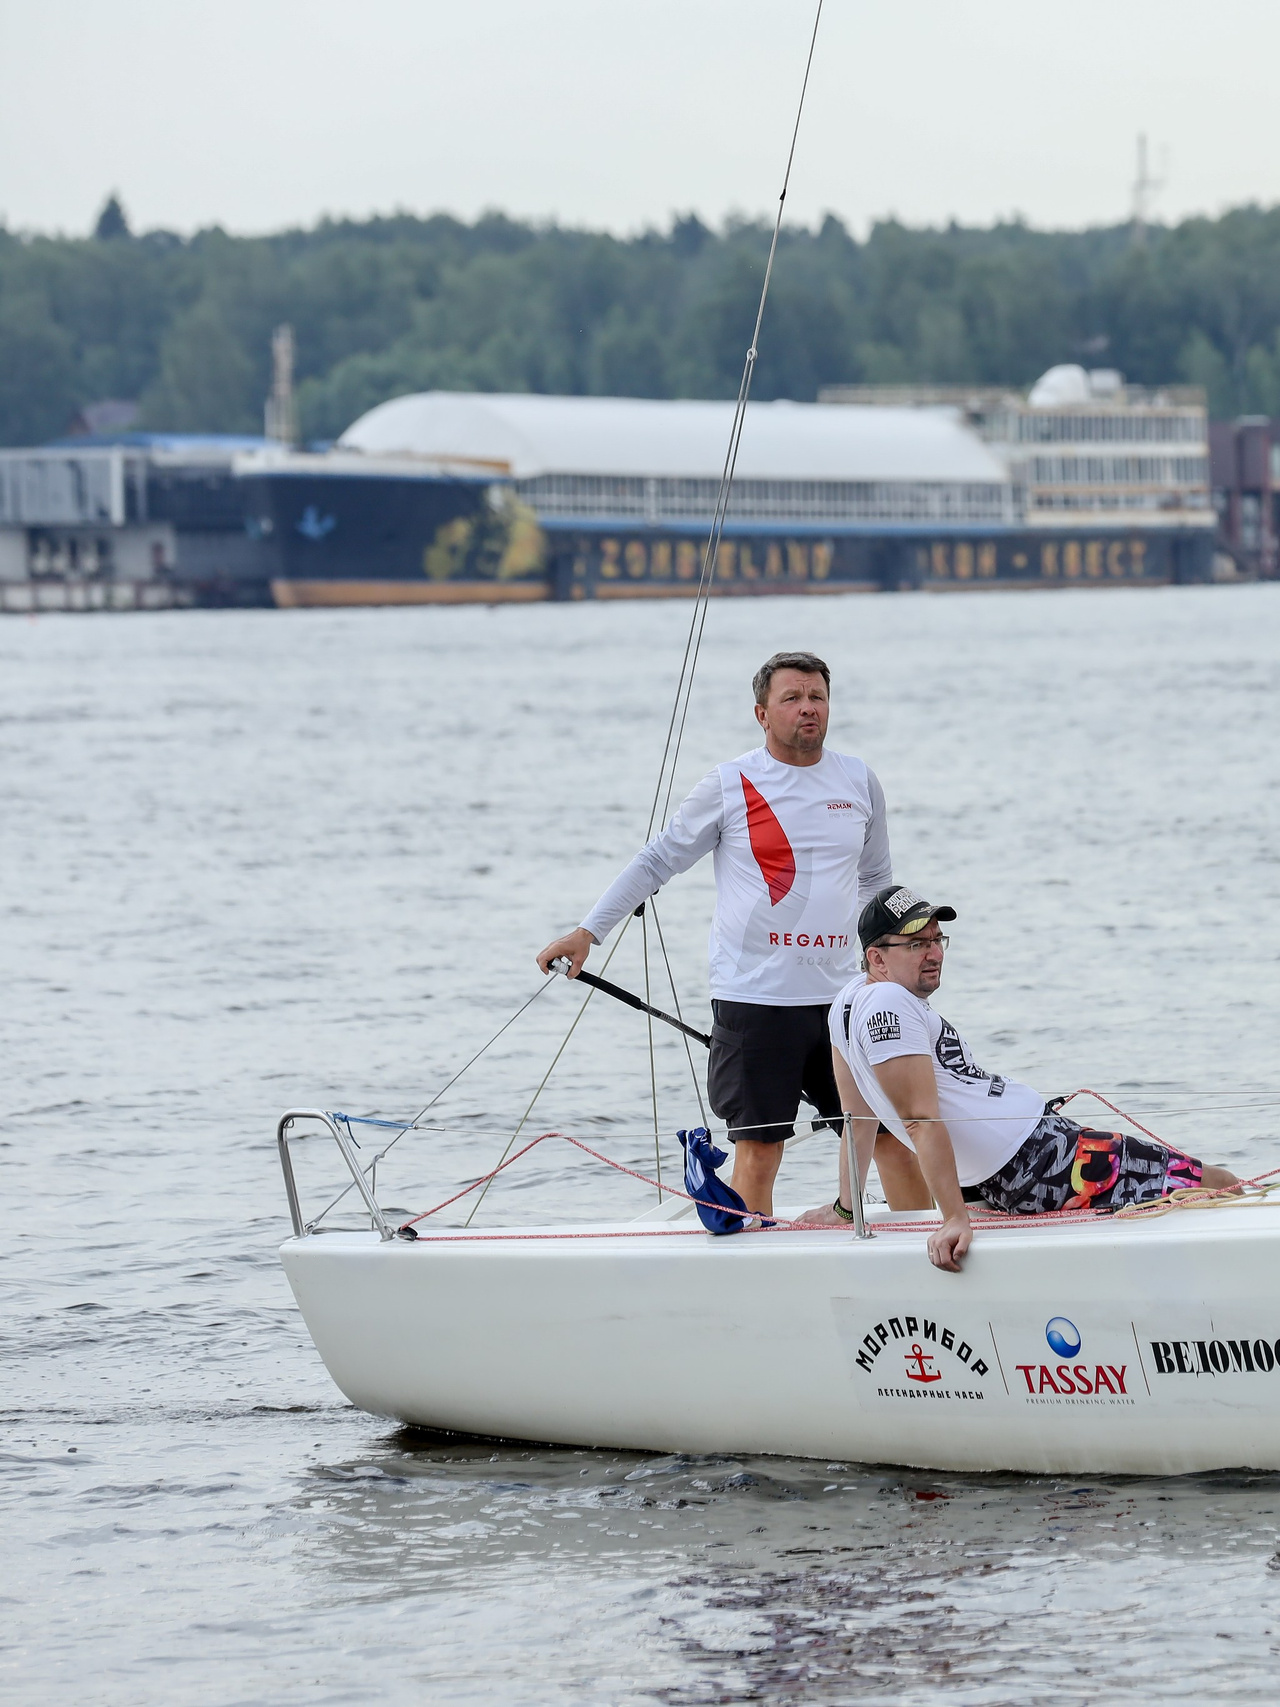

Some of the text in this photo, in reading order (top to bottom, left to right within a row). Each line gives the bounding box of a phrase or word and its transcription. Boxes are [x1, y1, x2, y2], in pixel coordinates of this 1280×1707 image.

[769, 932, 848, 948] REGATTA
[796, 956, 831, 966] 2024
[855, 1316, 989, 1377] МОРПРИБОР
[1015, 1365, 1128, 1395] TASSAY
[877, 1388, 984, 1400] ЛЕГЕНДАРНЫЕ ЧАСЫ
